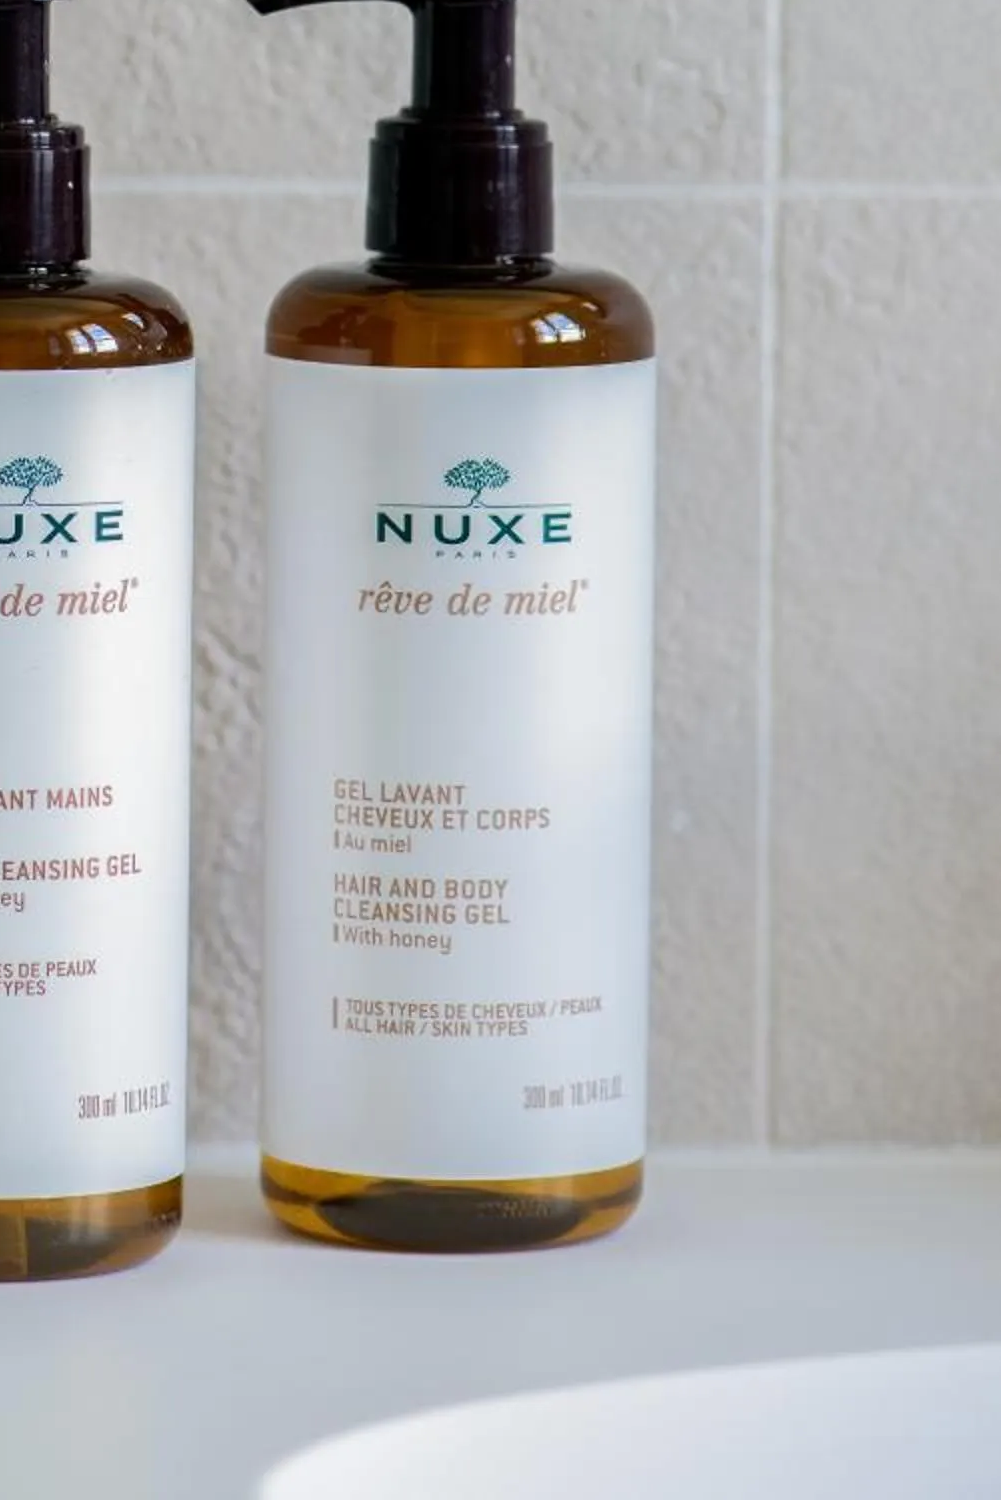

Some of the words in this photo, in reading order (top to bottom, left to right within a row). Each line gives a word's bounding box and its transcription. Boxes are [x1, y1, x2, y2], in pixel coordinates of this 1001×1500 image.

[376, 512, 572, 545] NUXE
[0, 583, 44, 618] de
[358, 581, 433, 615] rêve
[448, 583, 493, 617] de
[46, 785, 114, 810] MAINS
[334, 779, 373, 802] GEL
[380, 781, 466, 805] LAVANT
[334, 804, 434, 830] CHEVEUX
[442, 809, 469, 831] ET
[476, 808, 551, 831] CORPS
[344, 832, 365, 851] Au
[370, 834, 412, 854] miel
[106, 853, 142, 877] GEL
[334, 874, 382, 897] HAIR
[389, 878, 436, 900] AND
[444, 879, 509, 900] BODY
[334, 898, 457, 925] CLEANSING
[465, 904, 511, 925] GEL
[343, 925, 383, 947] With
[389, 928, 452, 955] honey
[18, 963, 41, 979] DE
[46, 959, 97, 978] PEAUX
[346, 998, 384, 1016] TOUS
[388, 1001, 440, 1019] TYPES
[444, 1003, 467, 1020] DE
[472, 1003, 546, 1021] CHEVEUX
[560, 997, 602, 1015] PEAUX
[345, 1018, 372, 1034] ALL
[377, 1020, 415, 1036] HAIR
[432, 1021, 472, 1037] SKIN
[477, 1020, 529, 1037] TYPES
